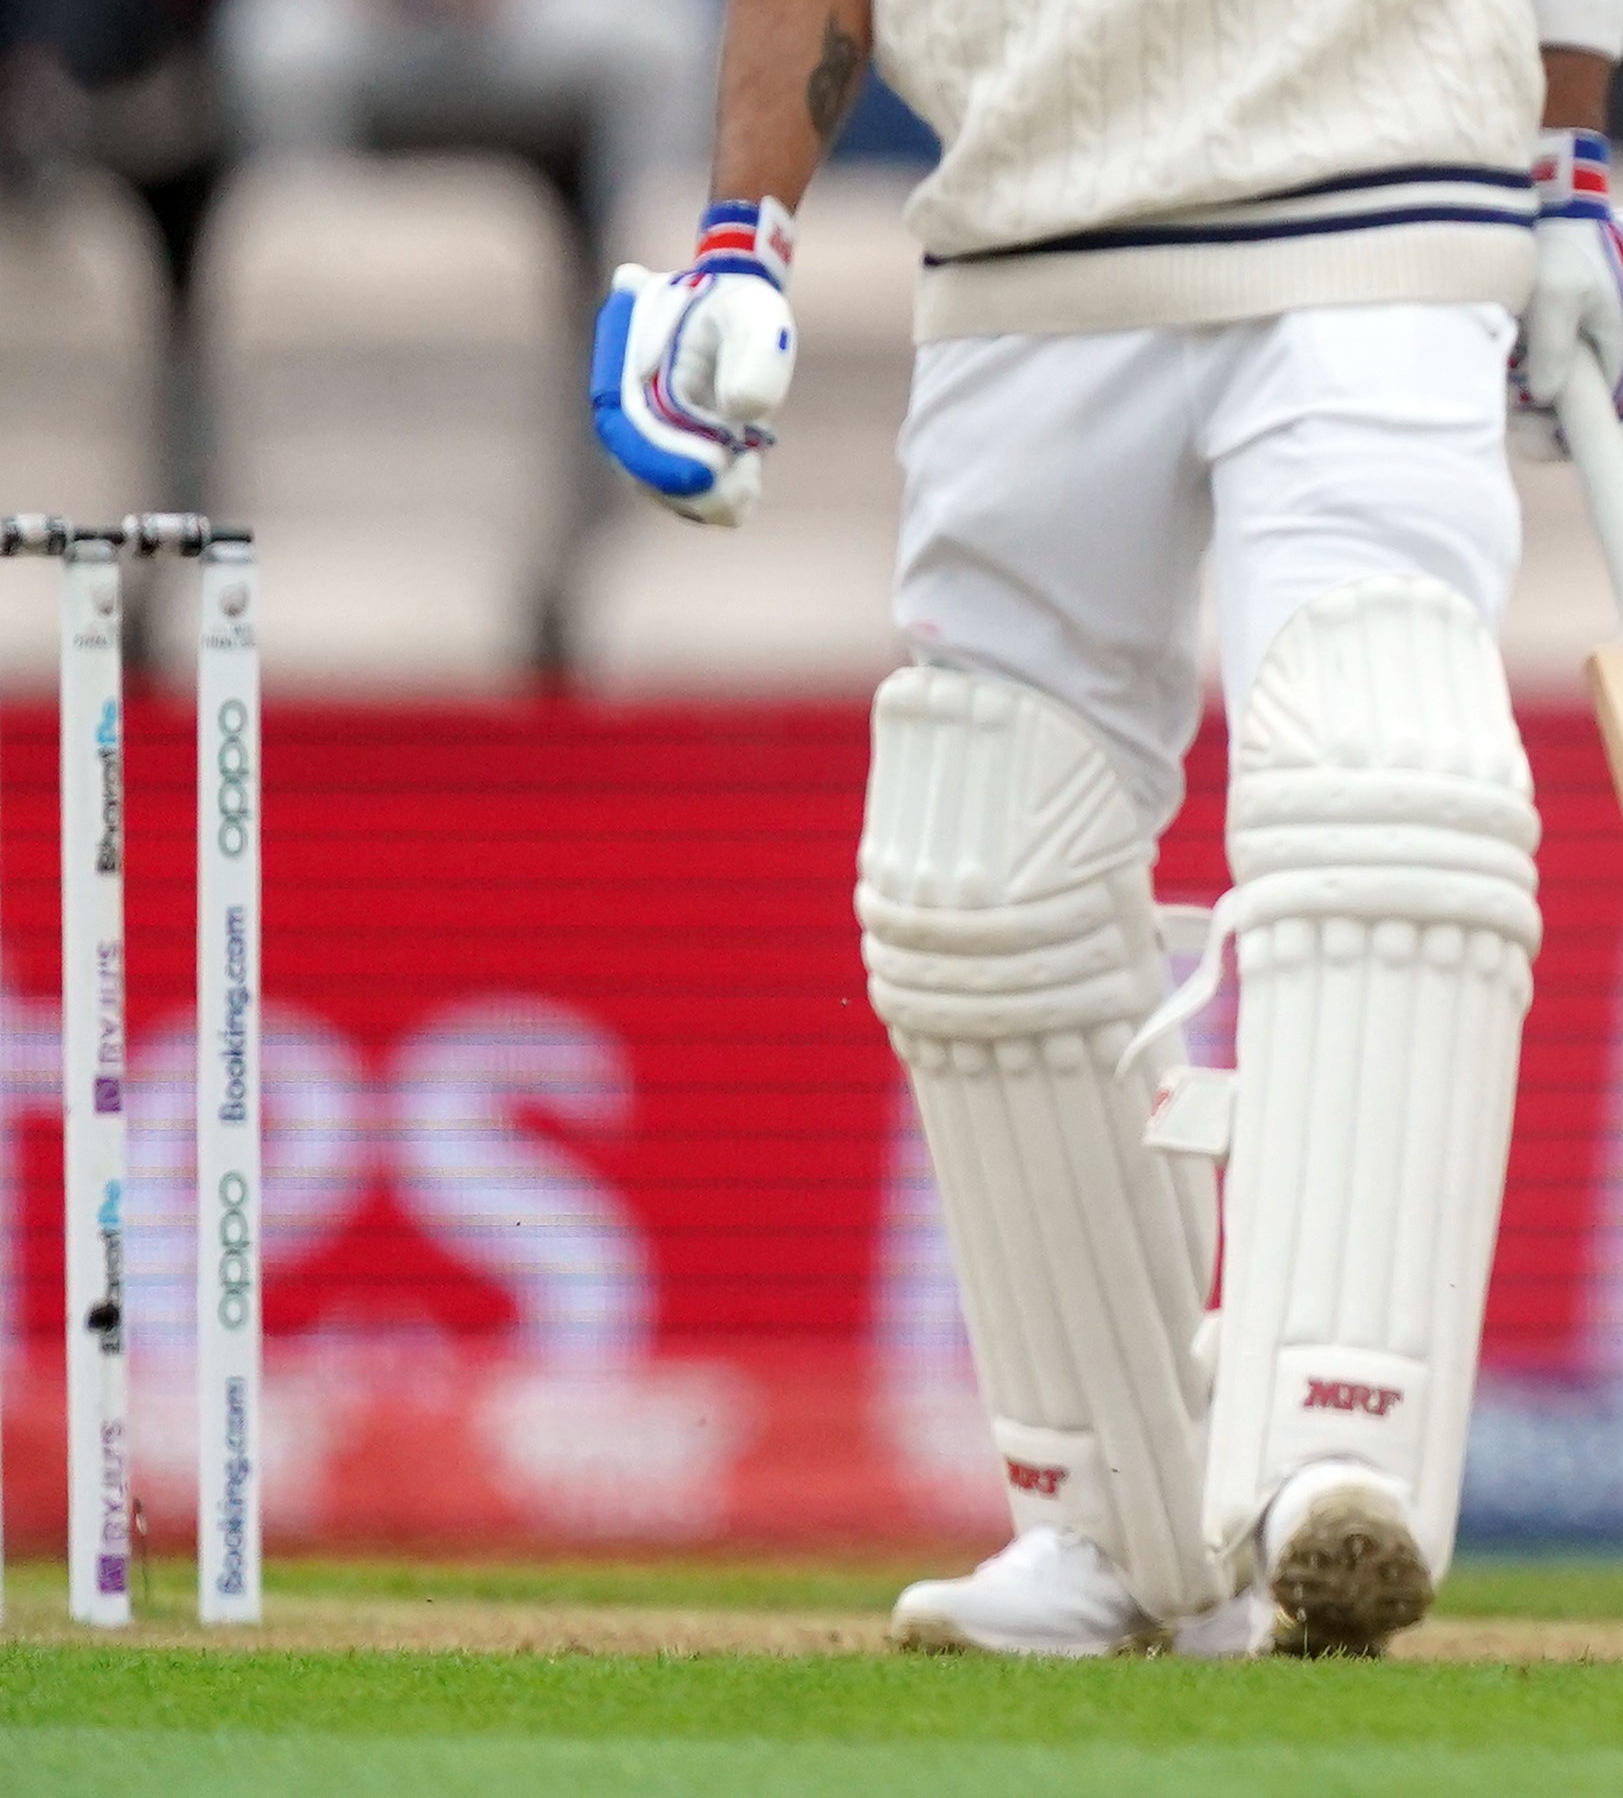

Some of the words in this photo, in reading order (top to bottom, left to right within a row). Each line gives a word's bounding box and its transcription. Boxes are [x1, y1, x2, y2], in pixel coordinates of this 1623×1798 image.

[217, 698, 250, 858] oppo
[218, 906, 251, 1122] Booking.com
[217, 1169, 250, 1331] oppo
[1304, 1379, 1402, 1416] MRF
[217, 1376, 251, 1595] Booking.com
